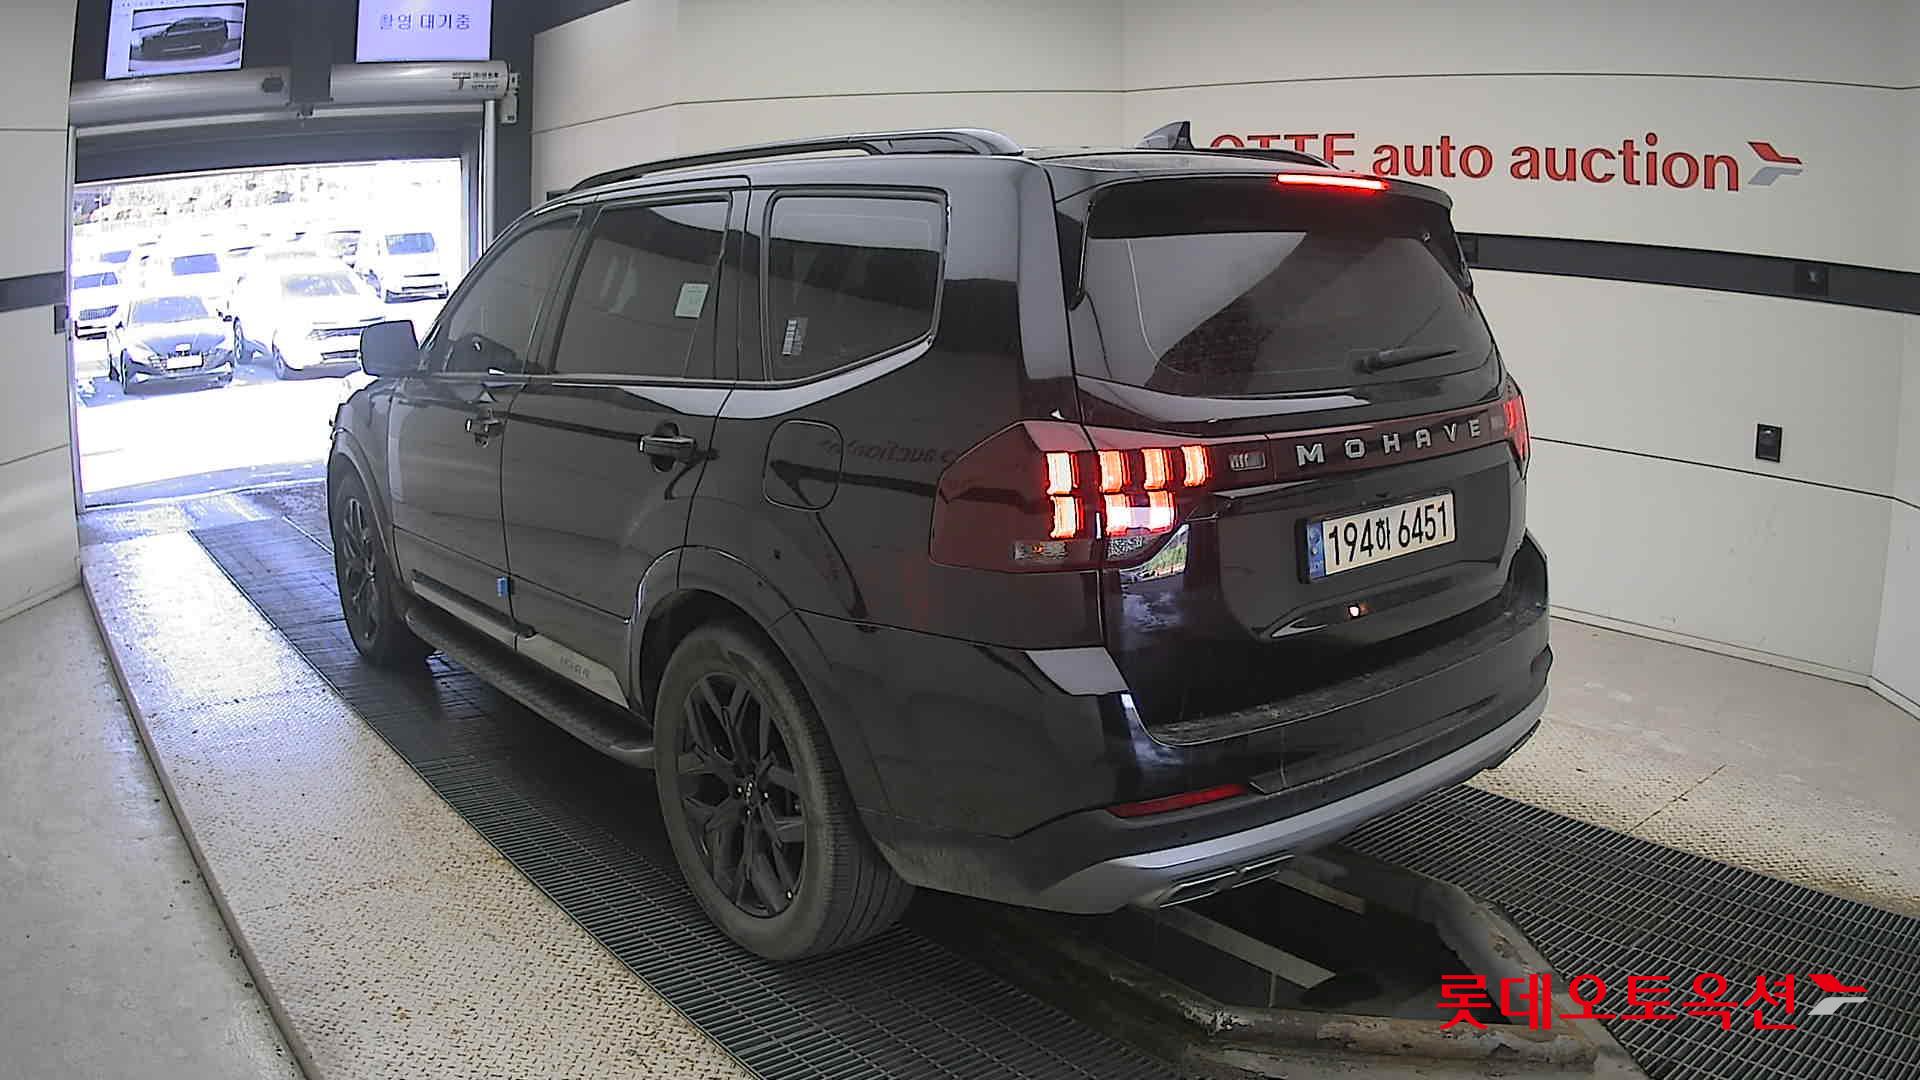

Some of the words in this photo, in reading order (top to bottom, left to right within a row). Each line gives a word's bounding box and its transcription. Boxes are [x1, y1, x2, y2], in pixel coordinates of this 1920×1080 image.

[420, 13, 472, 31] 대기중
[1372, 135, 1493, 178] auto
[1510, 132, 1739, 192] auction
[1296, 418, 1481, 466] MOHAVE
[1328, 516, 1391, 566] 194하
[1398, 500, 1448, 549] 6451
